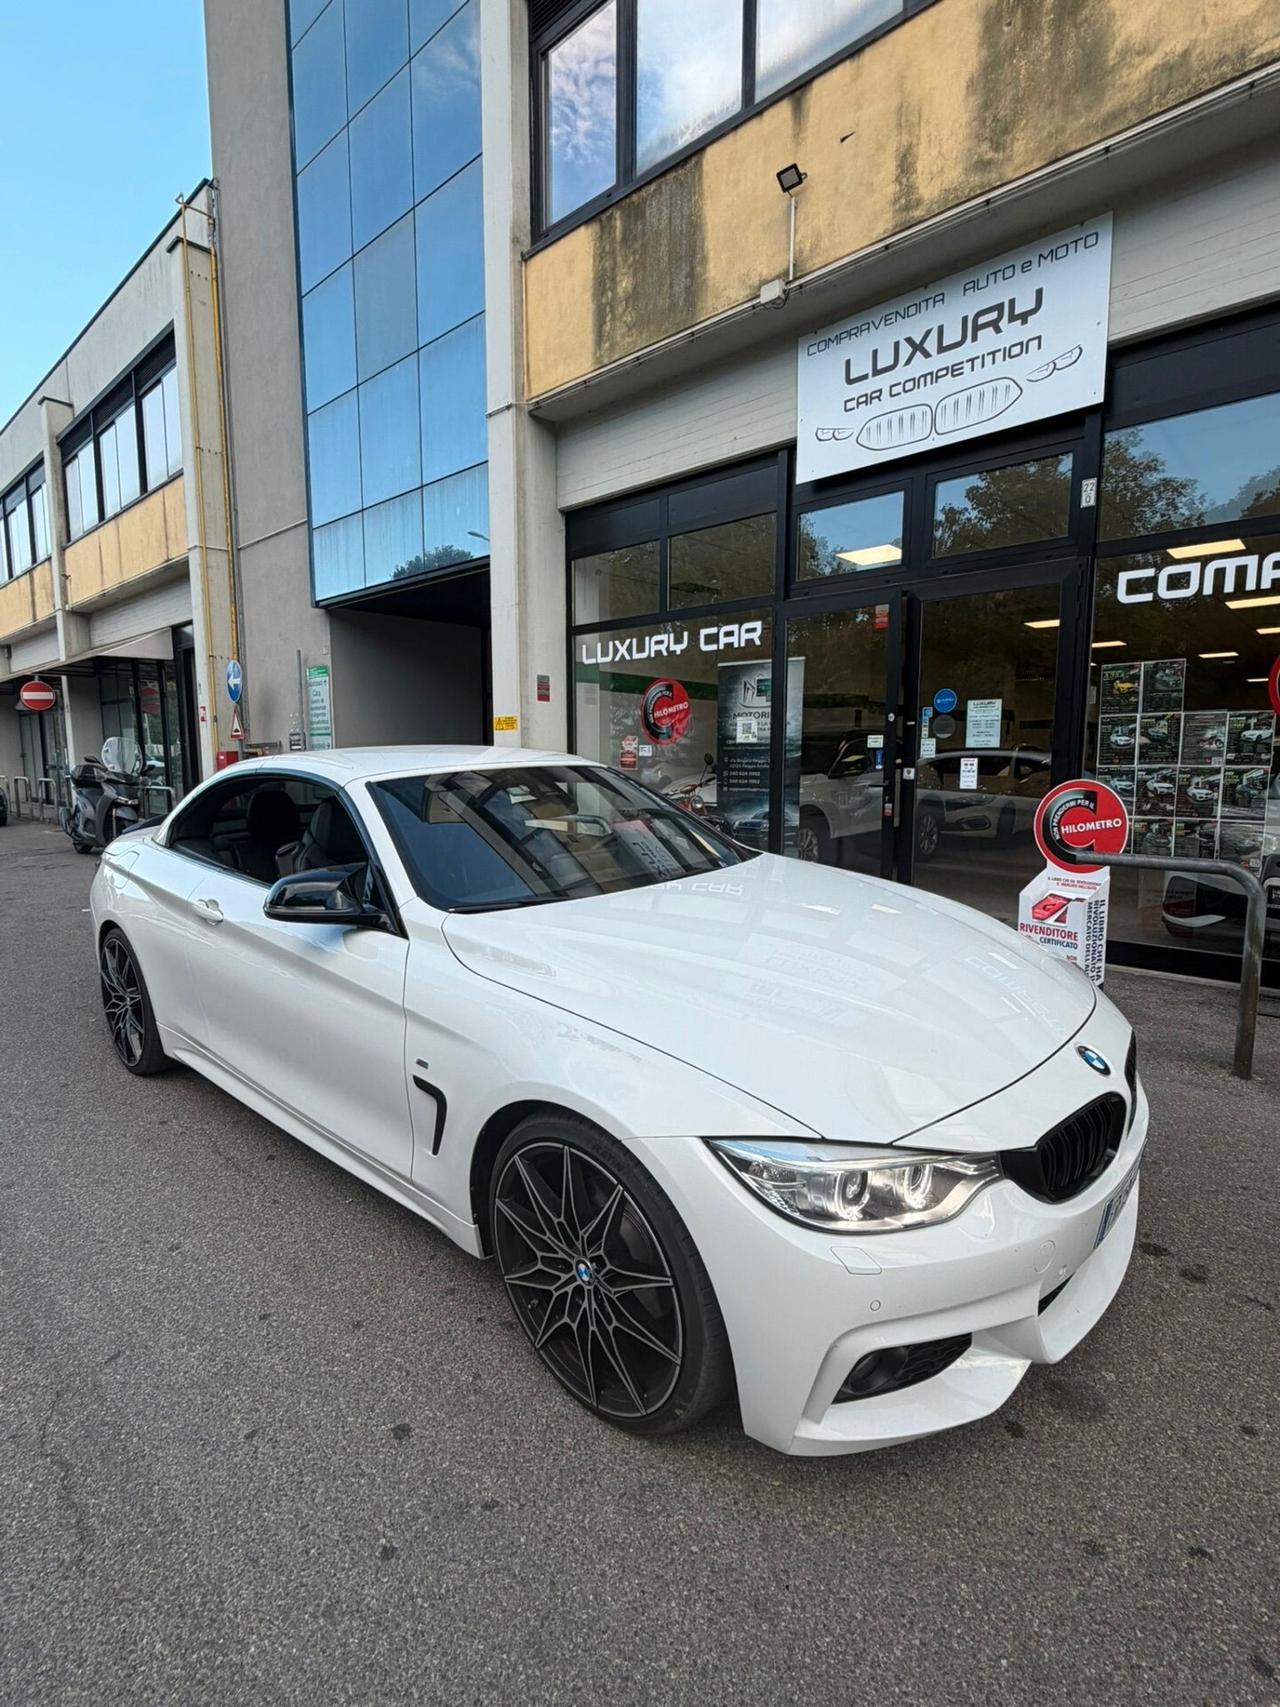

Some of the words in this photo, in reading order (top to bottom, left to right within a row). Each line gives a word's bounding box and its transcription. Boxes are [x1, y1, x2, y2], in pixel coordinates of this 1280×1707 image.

[806, 292, 946, 357] COMPRAVENDITA
[962, 264, 1016, 296] AUTO
[1020, 259, 1032, 274] e
[1038, 231, 1100, 271] MOTO
[844, 287, 1044, 385] LUXURY
[843, 388, 883, 413] CAR
[888, 335, 1043, 398] COMPETITION
[582, 631, 689, 665] LUXURY
[700, 620, 762, 652] CAR
[1020, 922, 1078, 941] RIVENDITORE
[1039, 936, 1078, 950] CERTIFICATO
[1097, 910, 1105, 941] LIBRO
[1096, 943, 1104, 963] CHE
